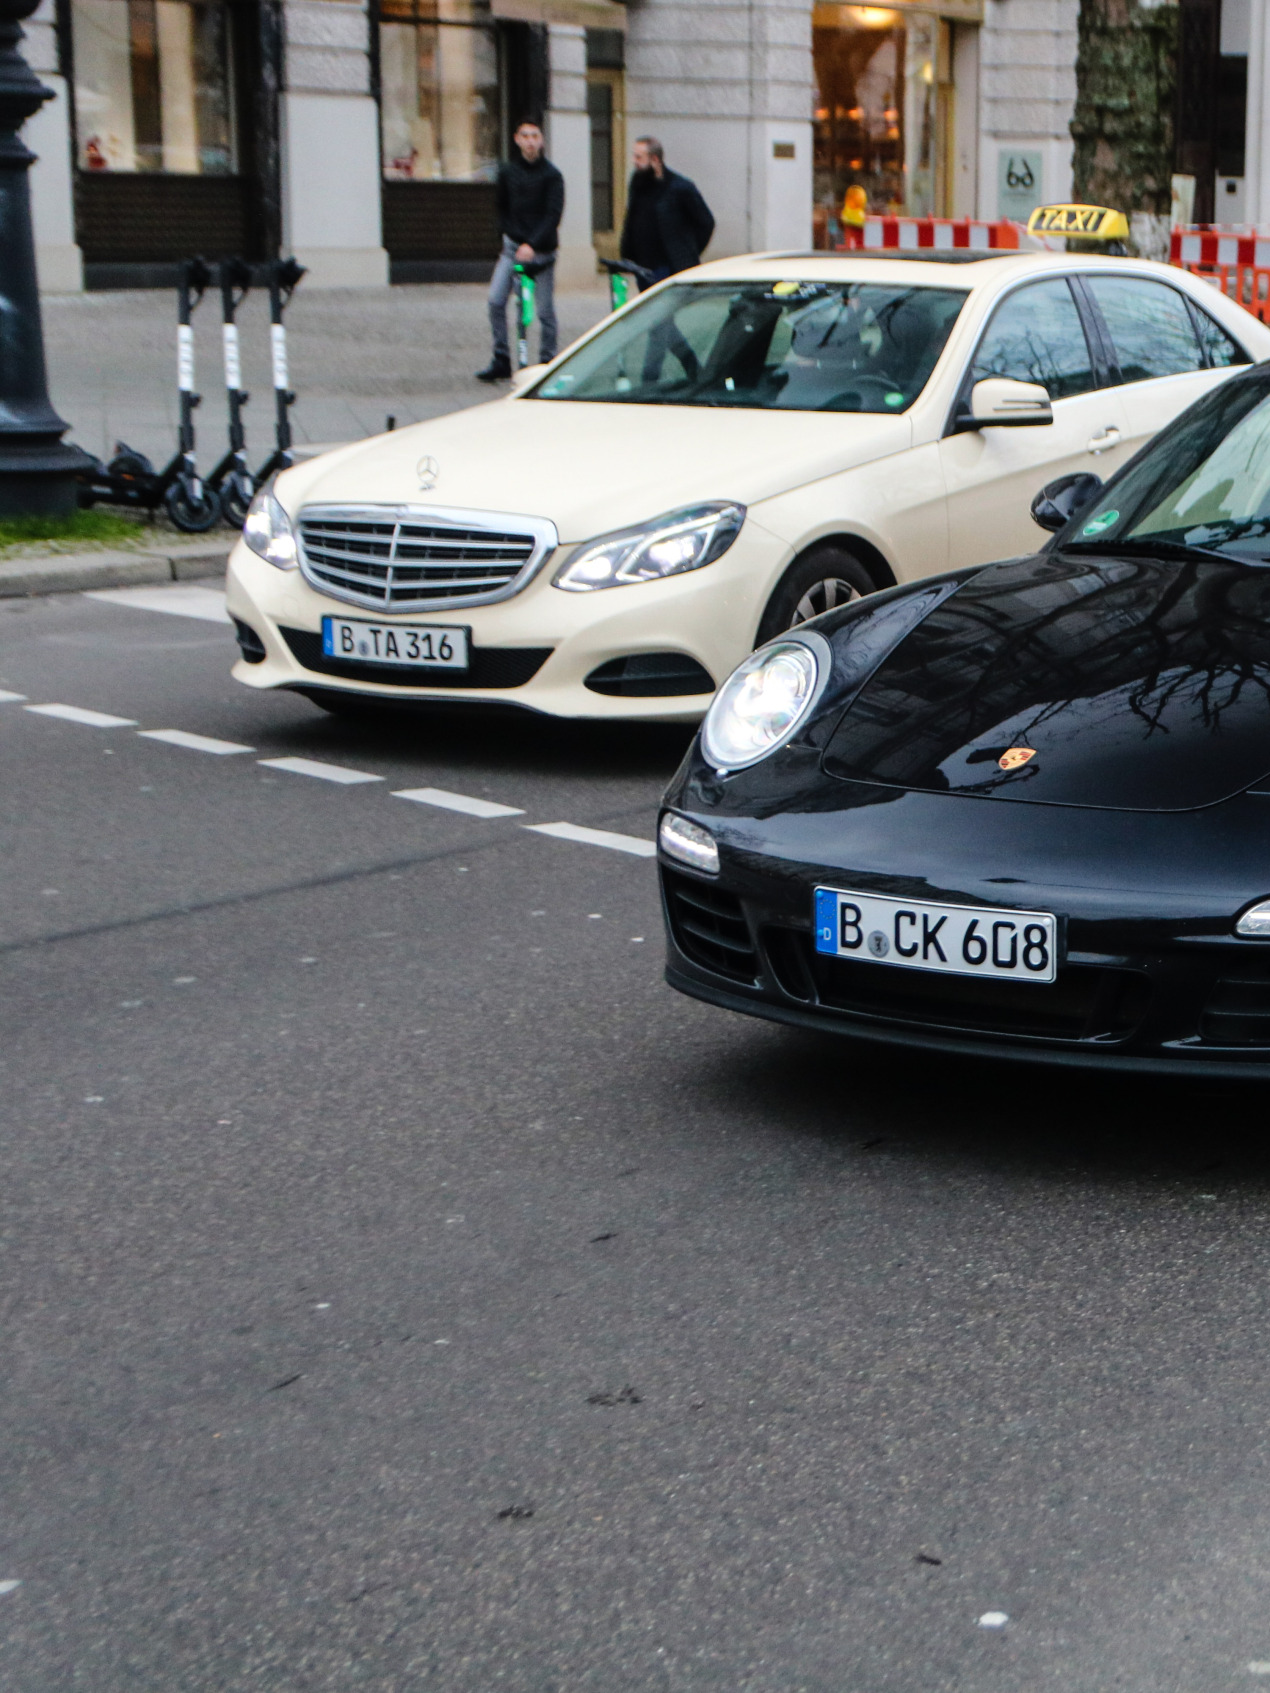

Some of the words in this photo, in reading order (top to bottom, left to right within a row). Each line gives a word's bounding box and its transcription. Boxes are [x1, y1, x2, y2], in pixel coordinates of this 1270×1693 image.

[1041, 209, 1100, 232] TAXI
[341, 626, 354, 653] B
[369, 629, 399, 657] TA
[405, 632, 453, 660] 316
[823, 927, 831, 941] D
[840, 902, 864, 950] B
[894, 909, 948, 963] CK
[962, 917, 1049, 972] 608
